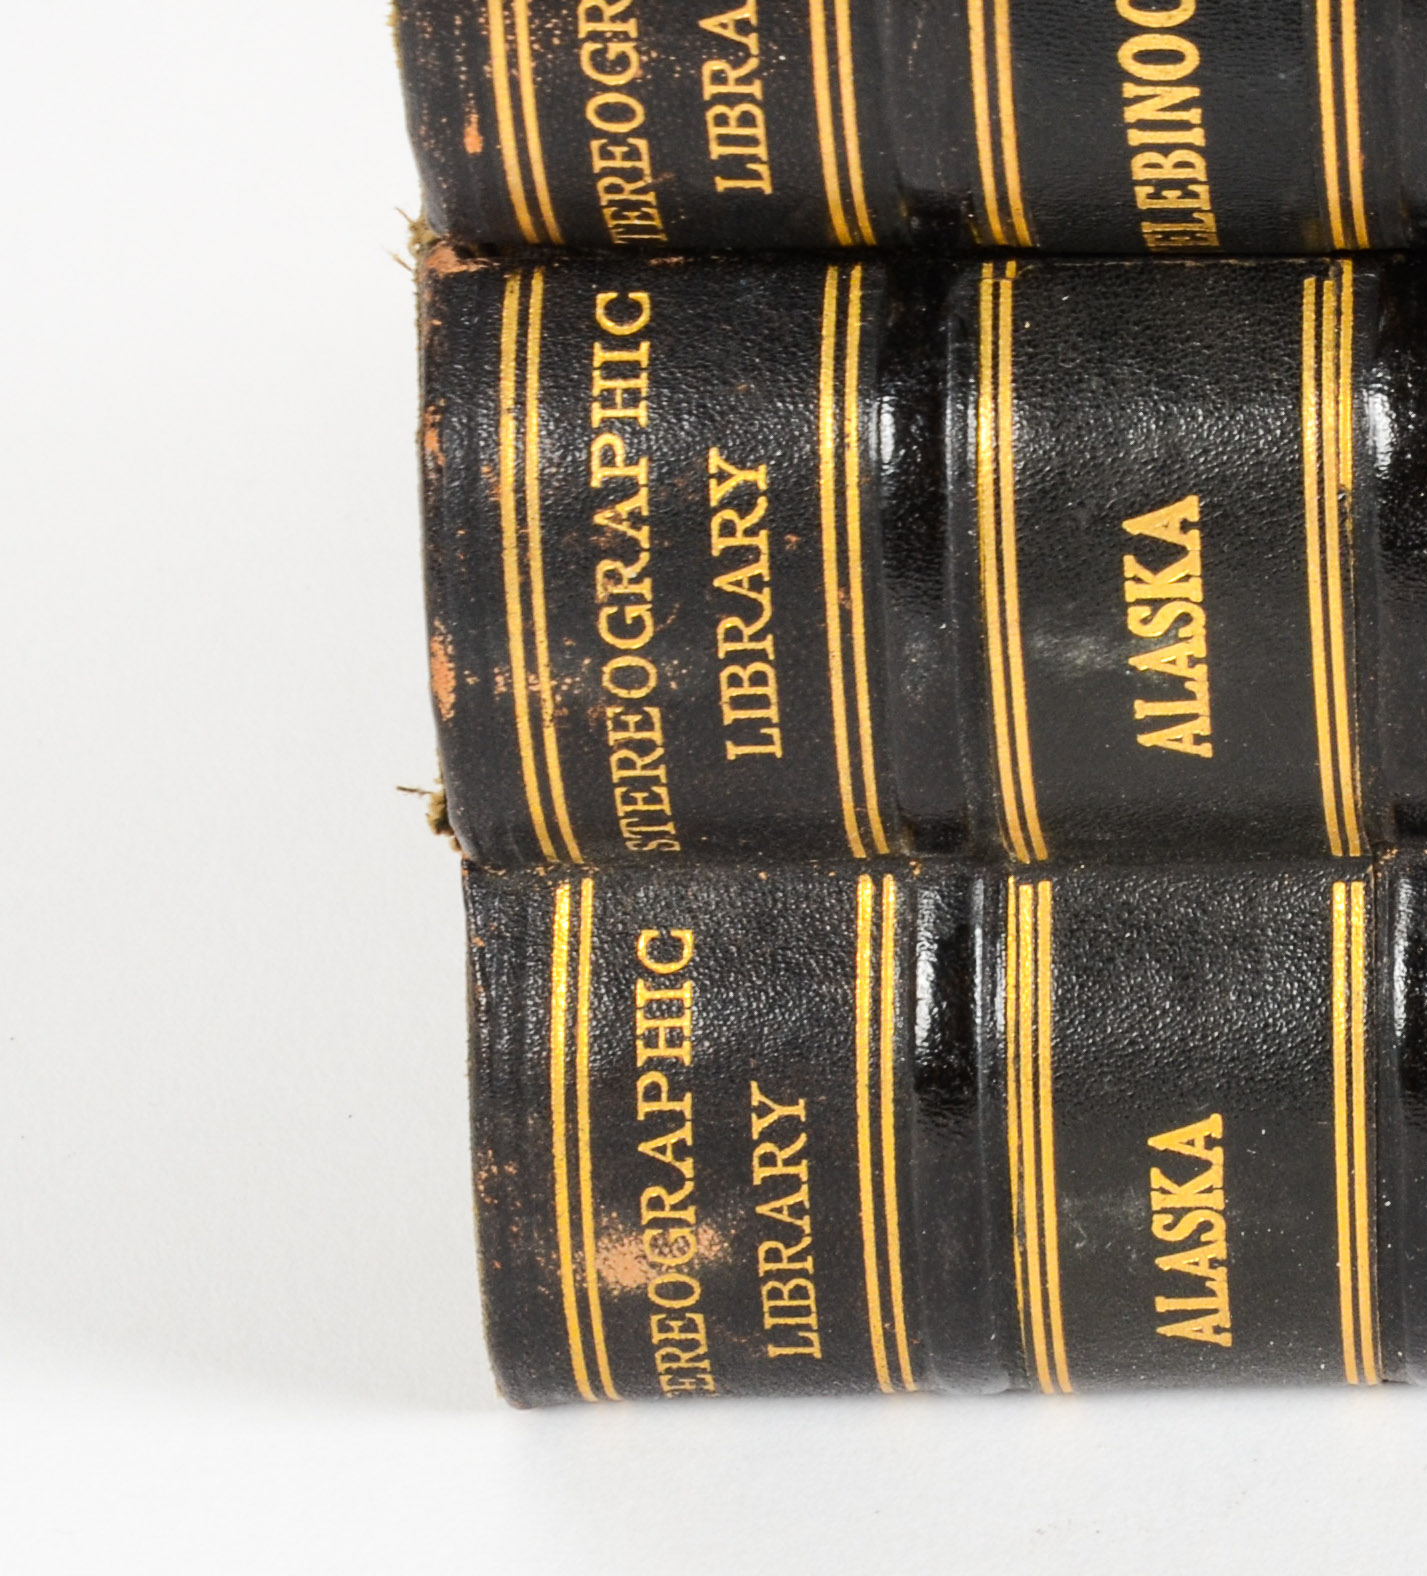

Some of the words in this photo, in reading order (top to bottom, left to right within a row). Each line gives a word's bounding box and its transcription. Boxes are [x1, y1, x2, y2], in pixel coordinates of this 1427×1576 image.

[590, 290, 681, 852] STEREOGRAPHIC
[707, 446, 783, 762] LIBRARY
[1120, 494, 1214, 759] ALASKA
[634, 928, 717, 1397] EREOGRAPHIC
[748, 1079, 823, 1360] LIBRARY
[1147, 1112, 1233, 1349] ALASKA
